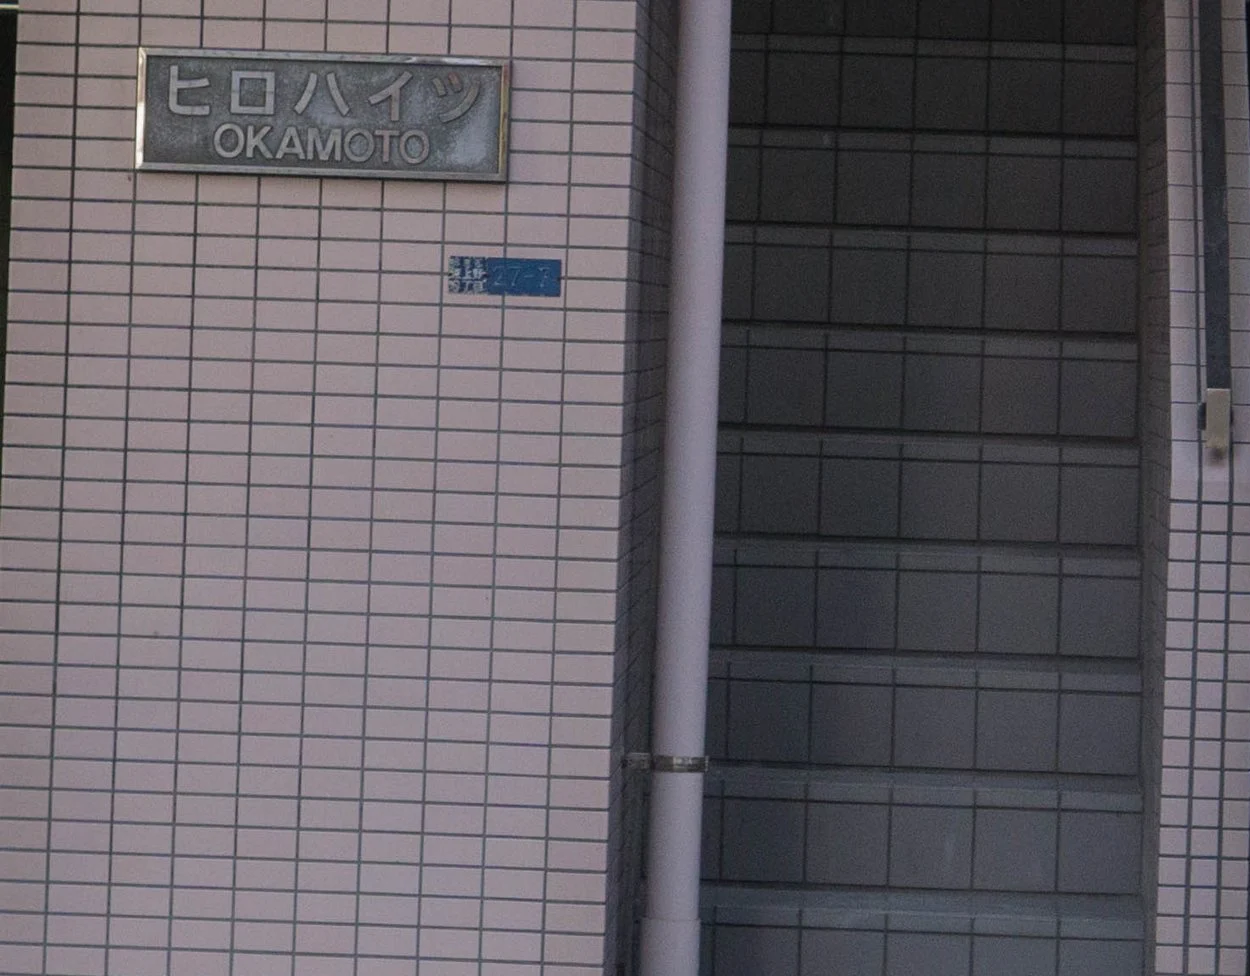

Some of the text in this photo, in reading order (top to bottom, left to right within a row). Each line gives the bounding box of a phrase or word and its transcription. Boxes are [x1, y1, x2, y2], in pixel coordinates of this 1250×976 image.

[168, 64, 482, 123] ヒロハイツ
[213, 122, 430, 164] OKAMOTO
